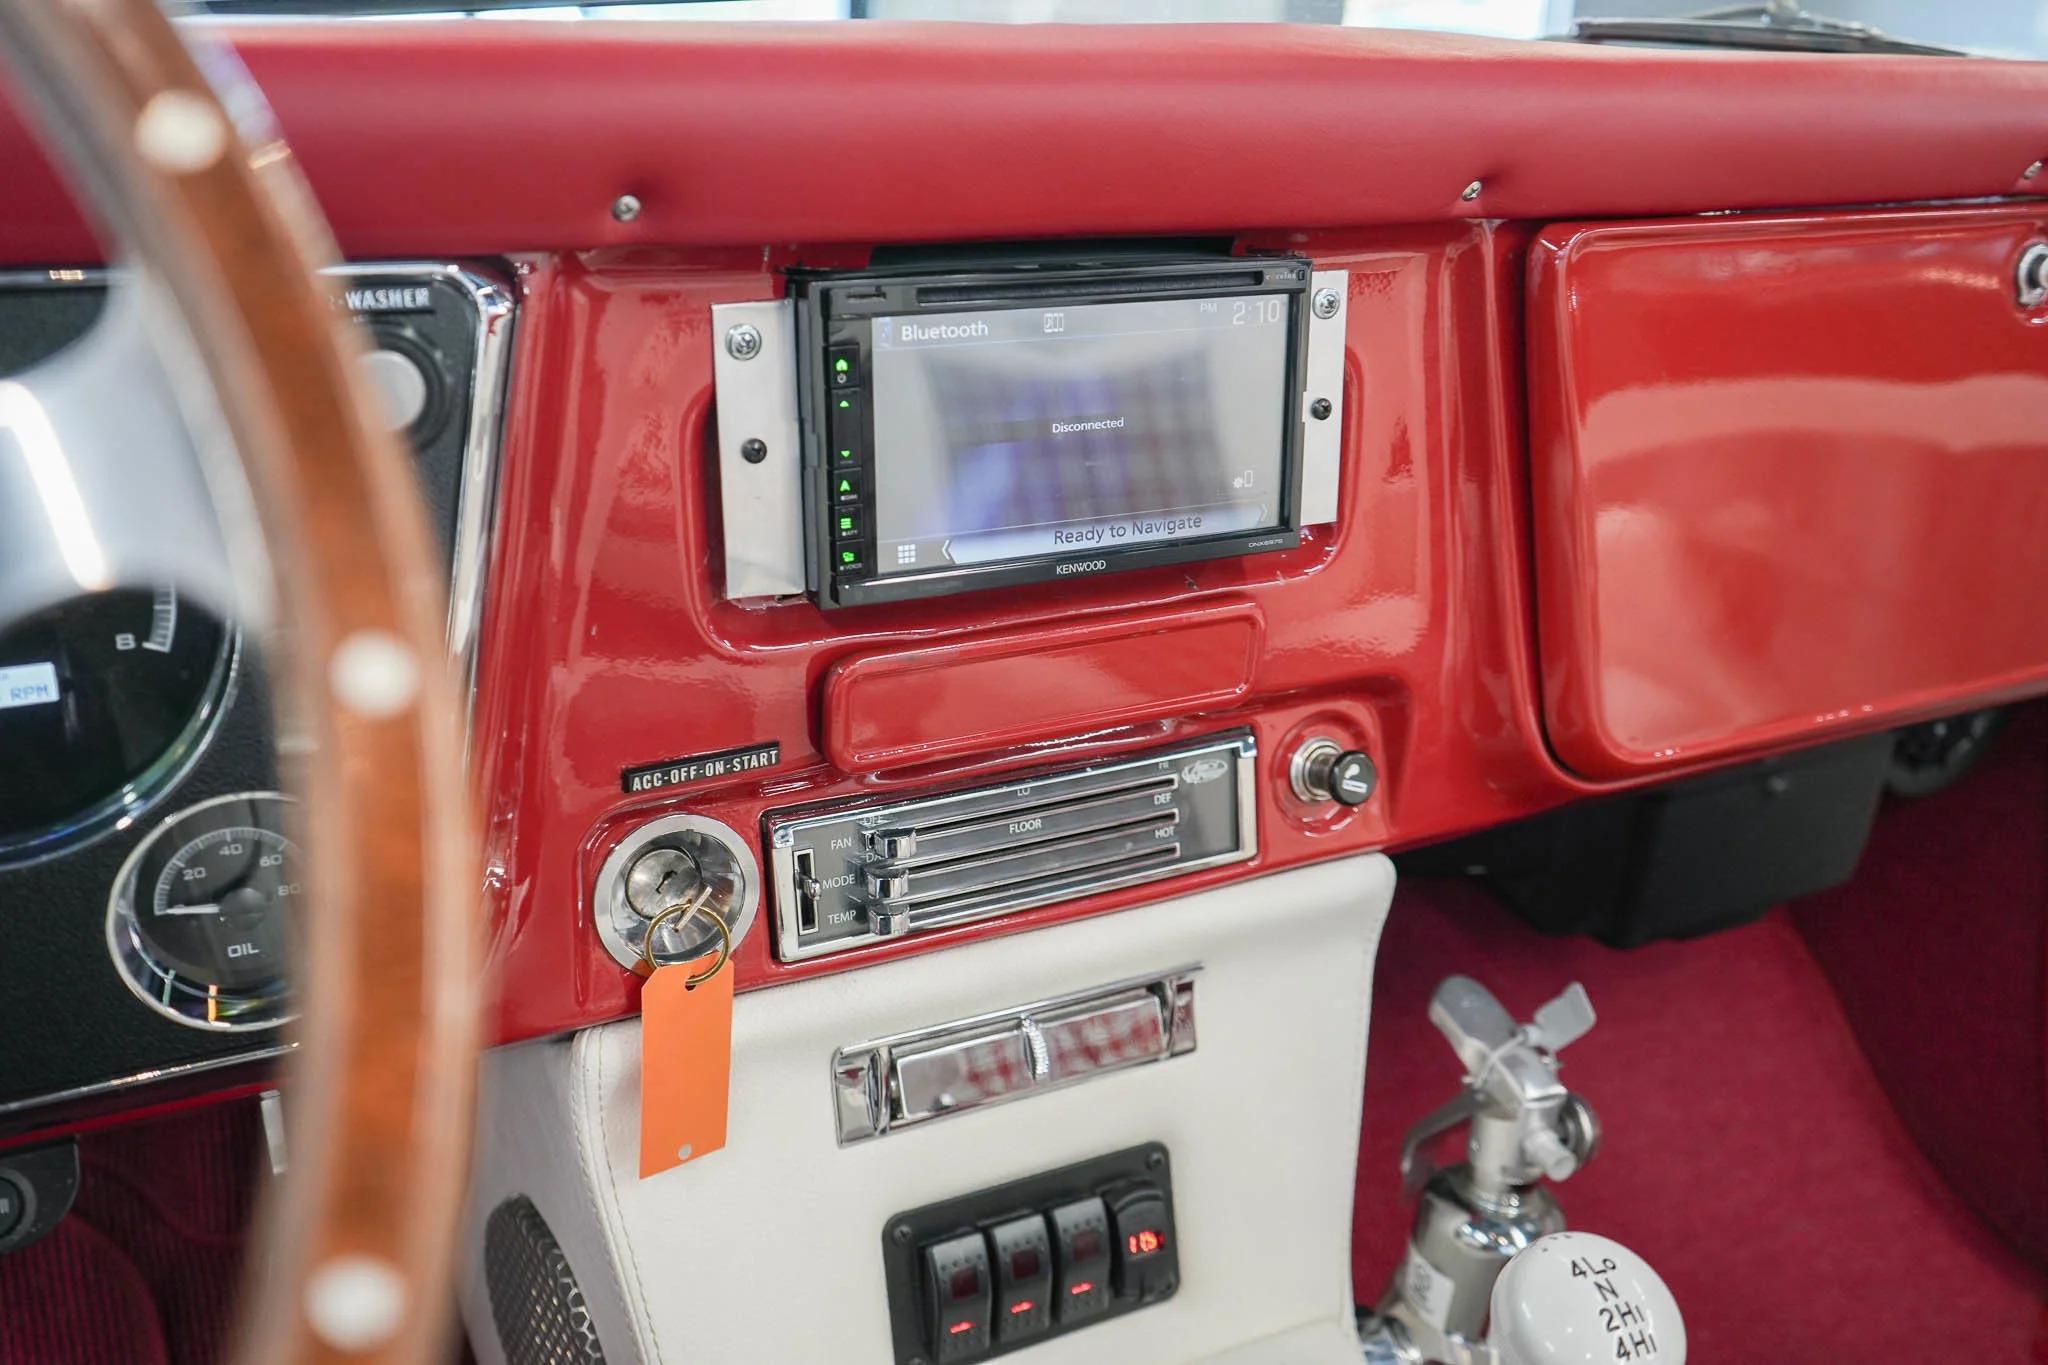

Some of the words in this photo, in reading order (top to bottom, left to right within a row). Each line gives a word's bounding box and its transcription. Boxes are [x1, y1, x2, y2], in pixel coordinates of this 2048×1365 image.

[1200, 302, 1218, 314] PM
[1231, 299, 1281, 326] 2:10
[901, 321, 989, 342] Bluetooth
[1051, 416, 1125, 434] Disconnected
[1053, 525, 1105, 545] Ready
[1109, 523, 1127, 538] to
[1131, 514, 1203, 536] Navigate
[1056, 559, 1107, 575] KENWOOD
[10, 684, 49, 702] RPM
[1153, 791, 1173, 805] DEF
[1009, 818, 1042, 835] FLOOR
[1155, 825, 1175, 839] HOT
[219, 843, 243, 857] 40
[831, 837, 852, 851] FAN
[260, 853, 283, 868] 60
[183, 867, 206, 881] 20
[822, 873, 856, 890] MODE
[827, 910, 857, 926] TEMP
[227, 942, 260, 958] OIL
[1594, 1277, 1620, 1303] N
